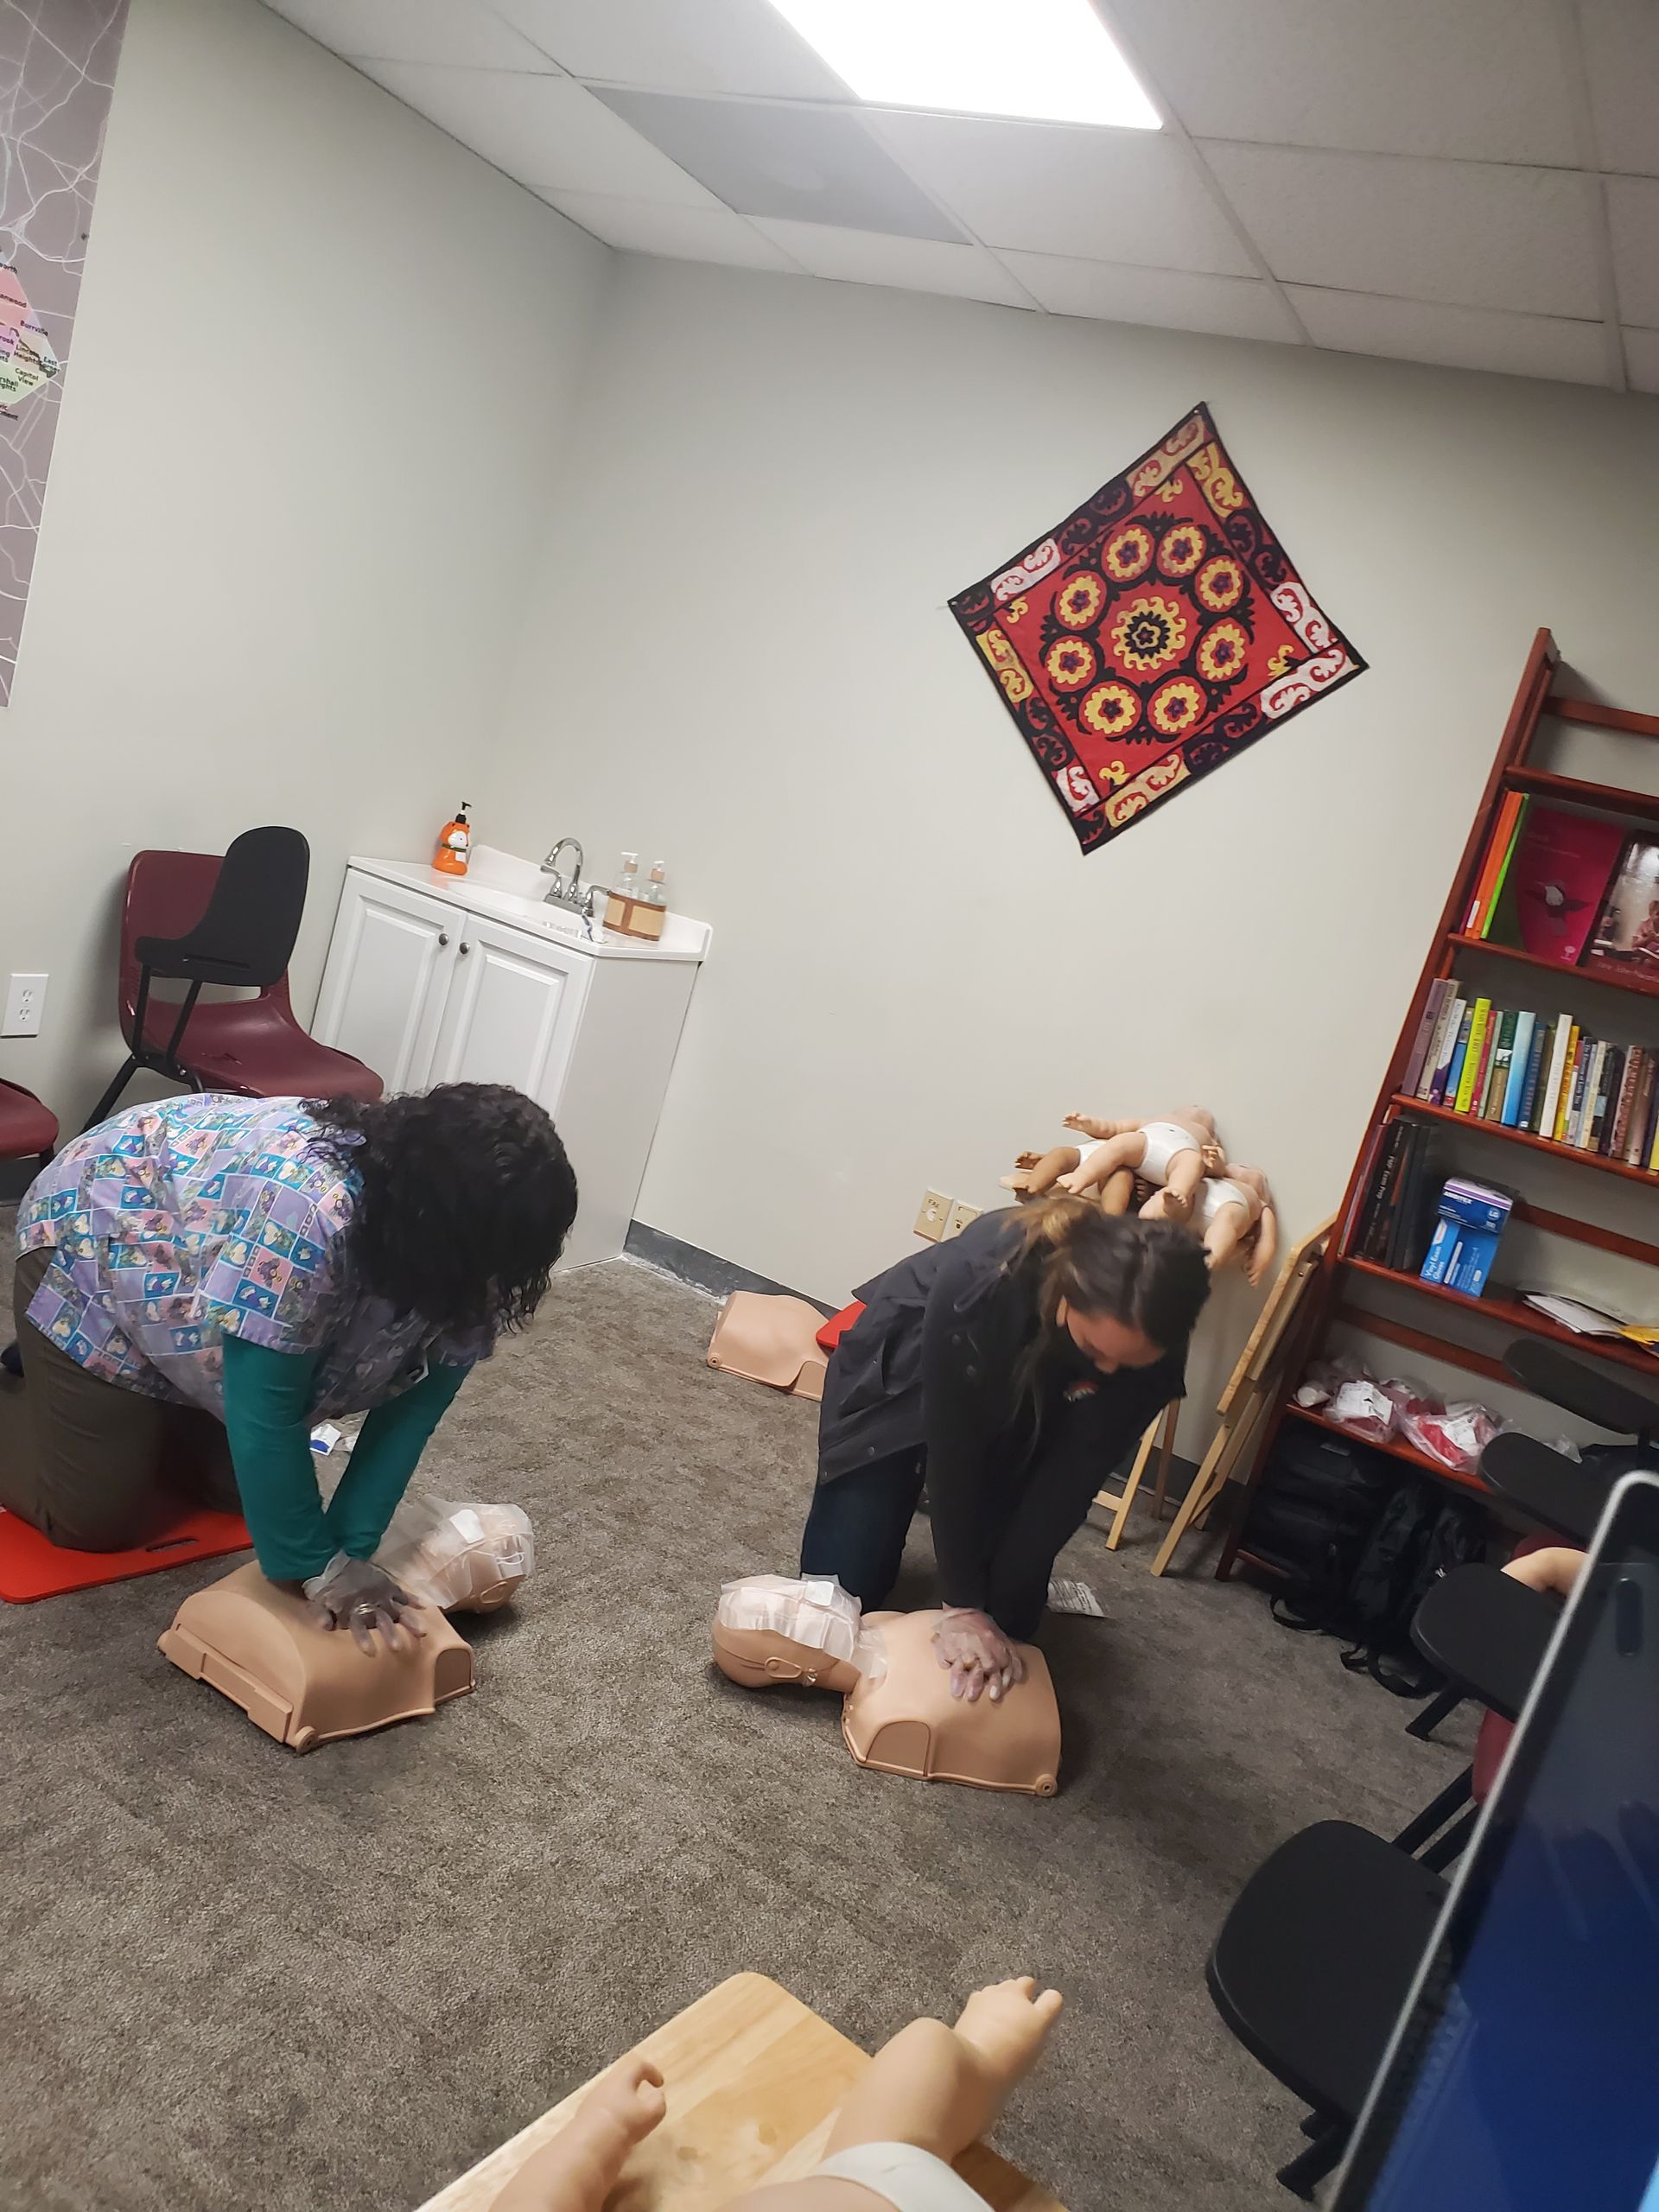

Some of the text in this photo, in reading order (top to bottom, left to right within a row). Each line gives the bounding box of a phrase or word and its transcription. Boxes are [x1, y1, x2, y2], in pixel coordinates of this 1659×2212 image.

[20, 319, 48, 337] Burrville
[43, 356, 58, 366] East
[15, 367, 39, 381] Capitol
[18, 375, 34, 386] View
[1381, 1170, 1390, 1185] Exam
[1376, 1185, 1385, 1199] Prep
